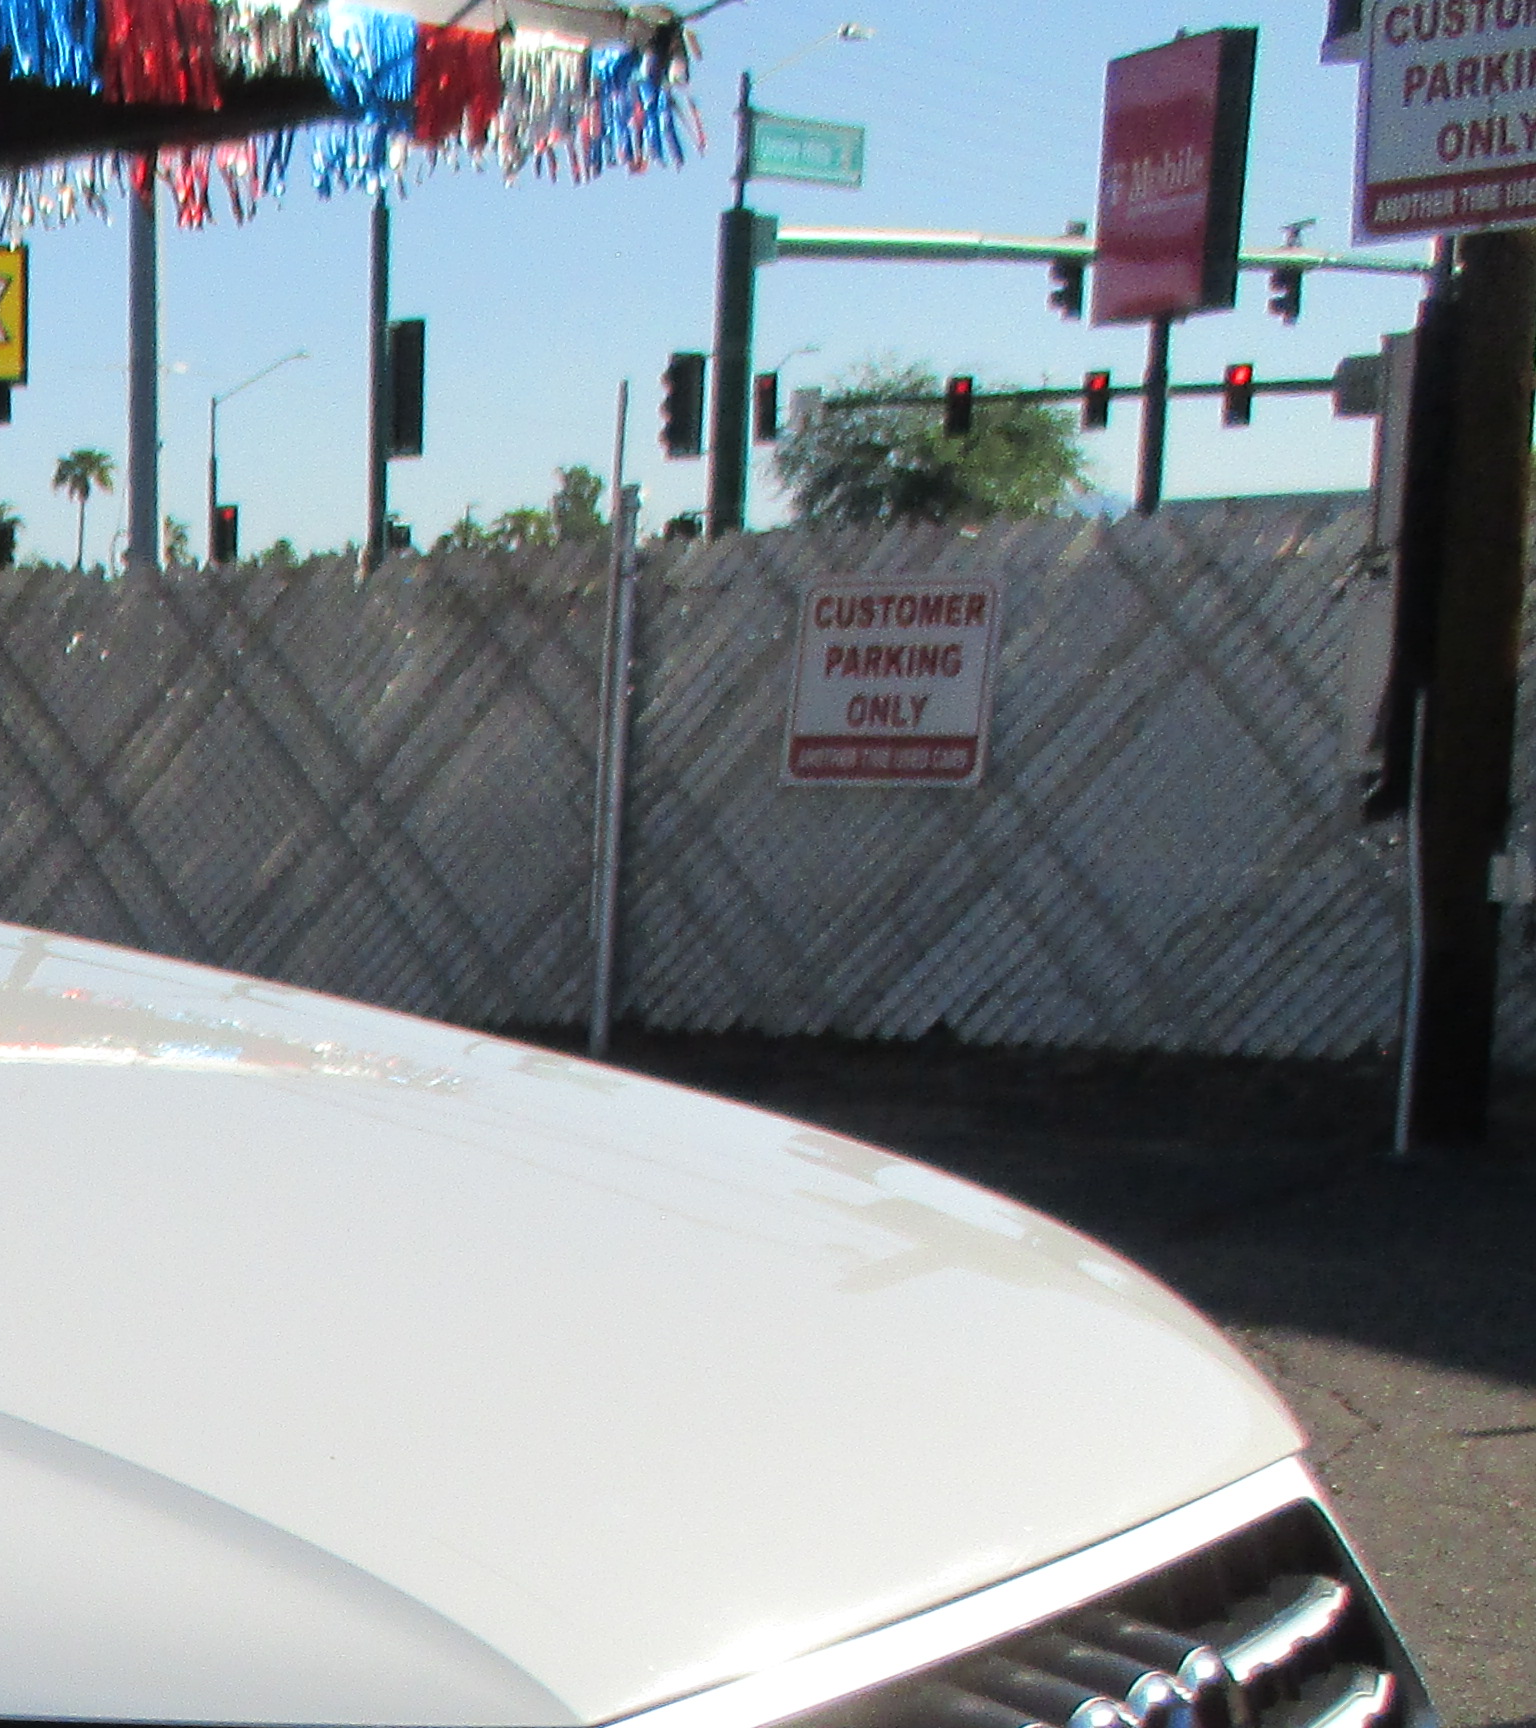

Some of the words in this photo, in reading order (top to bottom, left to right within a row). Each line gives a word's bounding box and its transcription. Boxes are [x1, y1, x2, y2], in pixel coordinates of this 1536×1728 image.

[1436, 112, 1536, 163] ONLY
[814, 594, 986, 629] CUSTOMER
[825, 643, 964, 678] PARKING
[846, 691, 928, 728] ONLY
